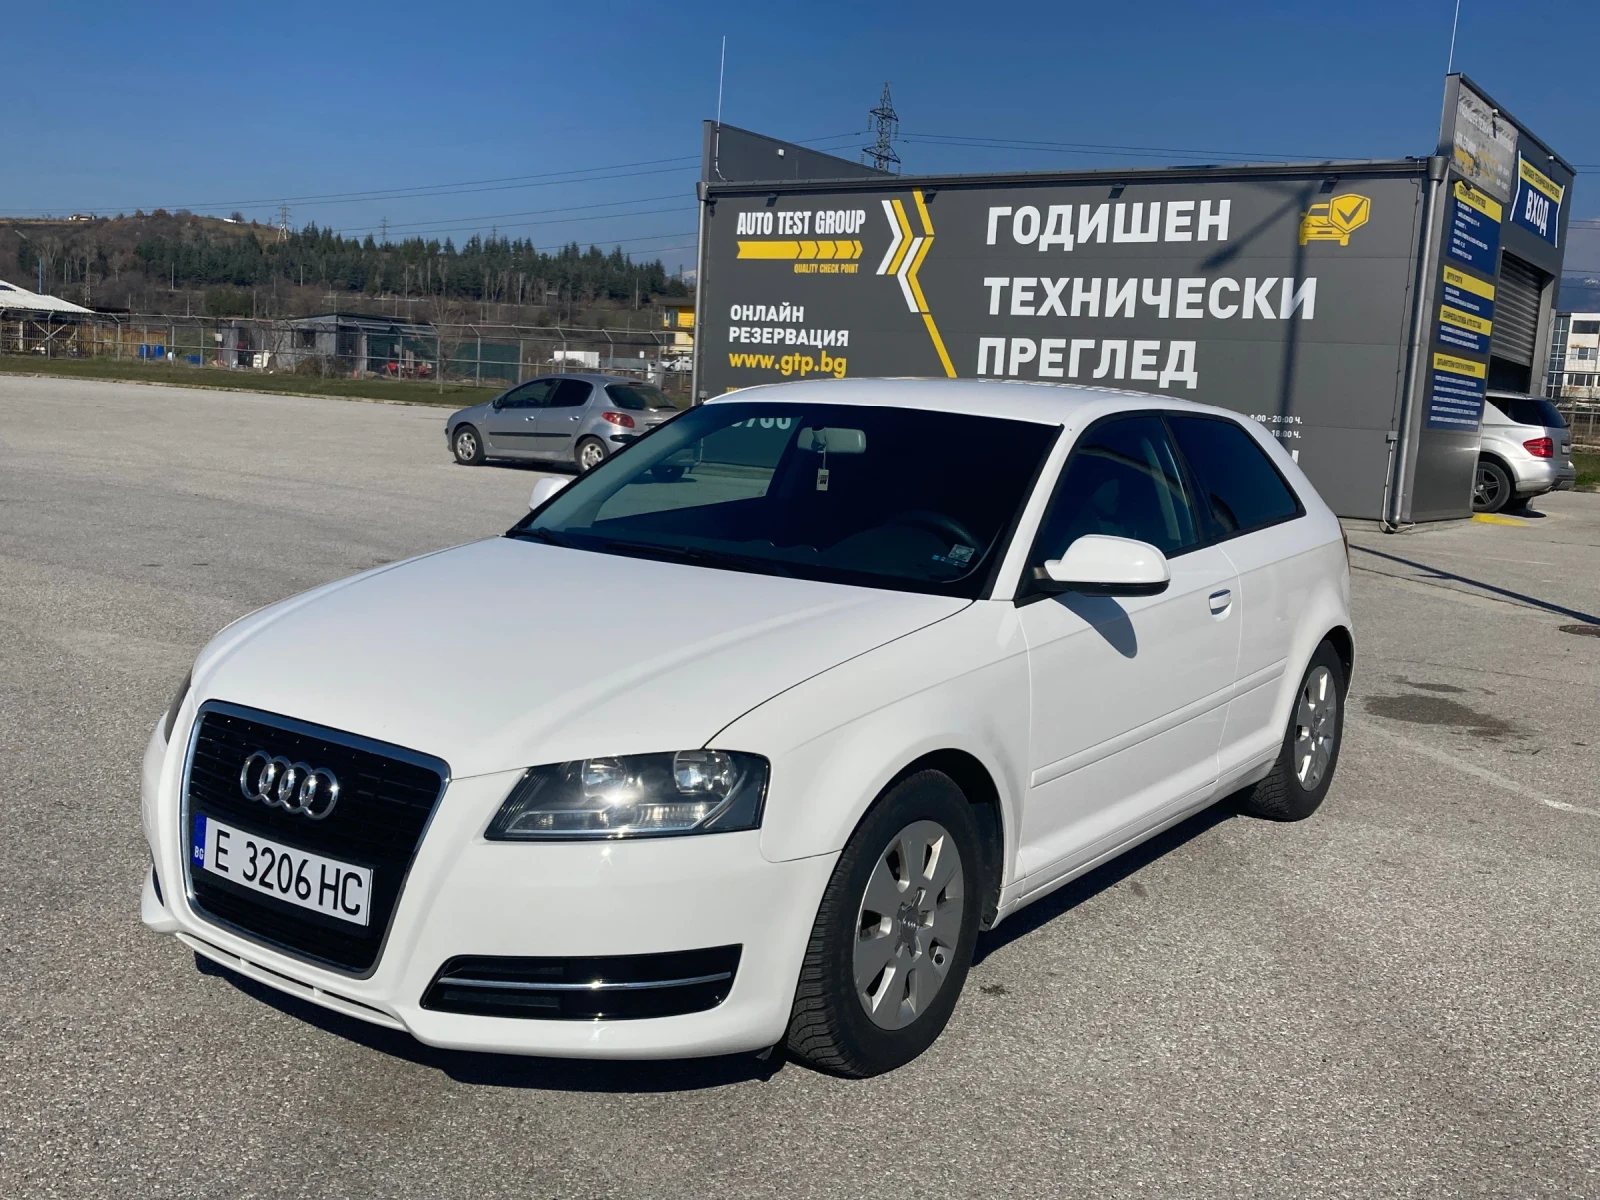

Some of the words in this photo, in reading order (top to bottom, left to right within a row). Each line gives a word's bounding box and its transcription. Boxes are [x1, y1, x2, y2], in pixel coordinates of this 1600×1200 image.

[736, 212, 774, 235] AUTO
[777, 211, 812, 235] TEST
[815, 210, 866, 234] GROUP
[986, 199, 1231, 252] ГОДИШЕН
[1525, 189, 1549, 236] ВХОД
[793, 263, 818, 274] QUALITY
[819, 263, 839, 274] CHECK
[840, 263, 859, 274] POINT
[983, 277, 1317, 320] ТЕХНИЧЕСКИ
[730, 302, 804, 323] ОНЛАЙН
[728, 326, 849, 349] РЕЗЕРВАЦИЯ
[728, 350, 847, 379] www.gtp.bg
[977, 337, 1198, 389] ПРЕГЛЕД
[1272, 415, 1293, 424] 20:00
[194, 846, 204, 860] BG
[215, 829, 230, 872] E
[242, 841, 311, 900] 3206
